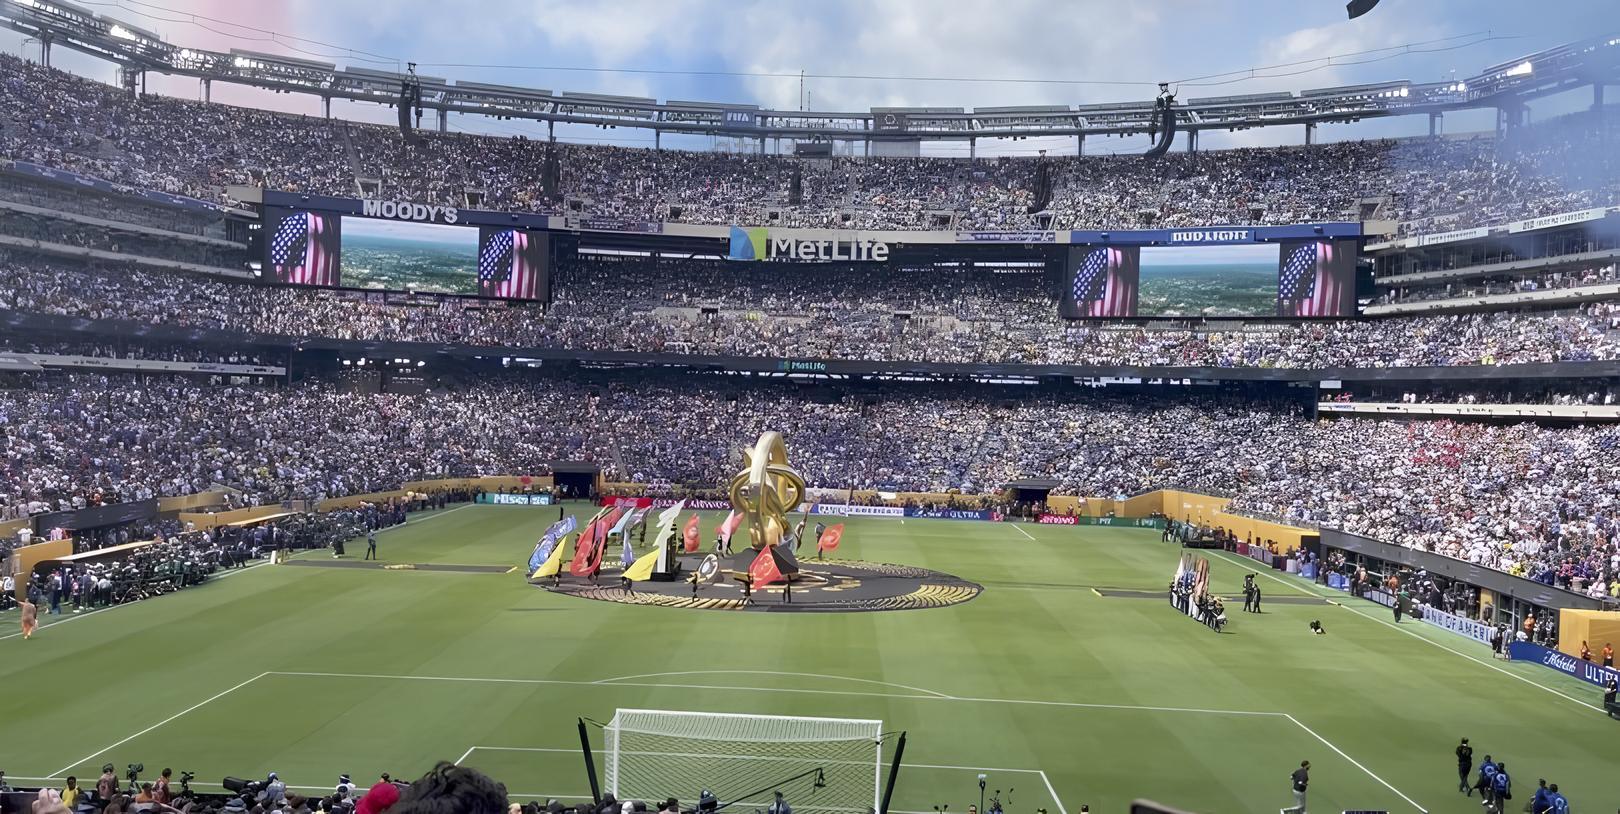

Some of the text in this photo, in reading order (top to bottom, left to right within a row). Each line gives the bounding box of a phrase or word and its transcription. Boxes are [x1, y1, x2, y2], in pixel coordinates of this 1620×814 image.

[363, 199, 458, 224] MOODY'S
[771, 233, 889, 261] MetLife
[1173, 232, 1203, 242] BUD
